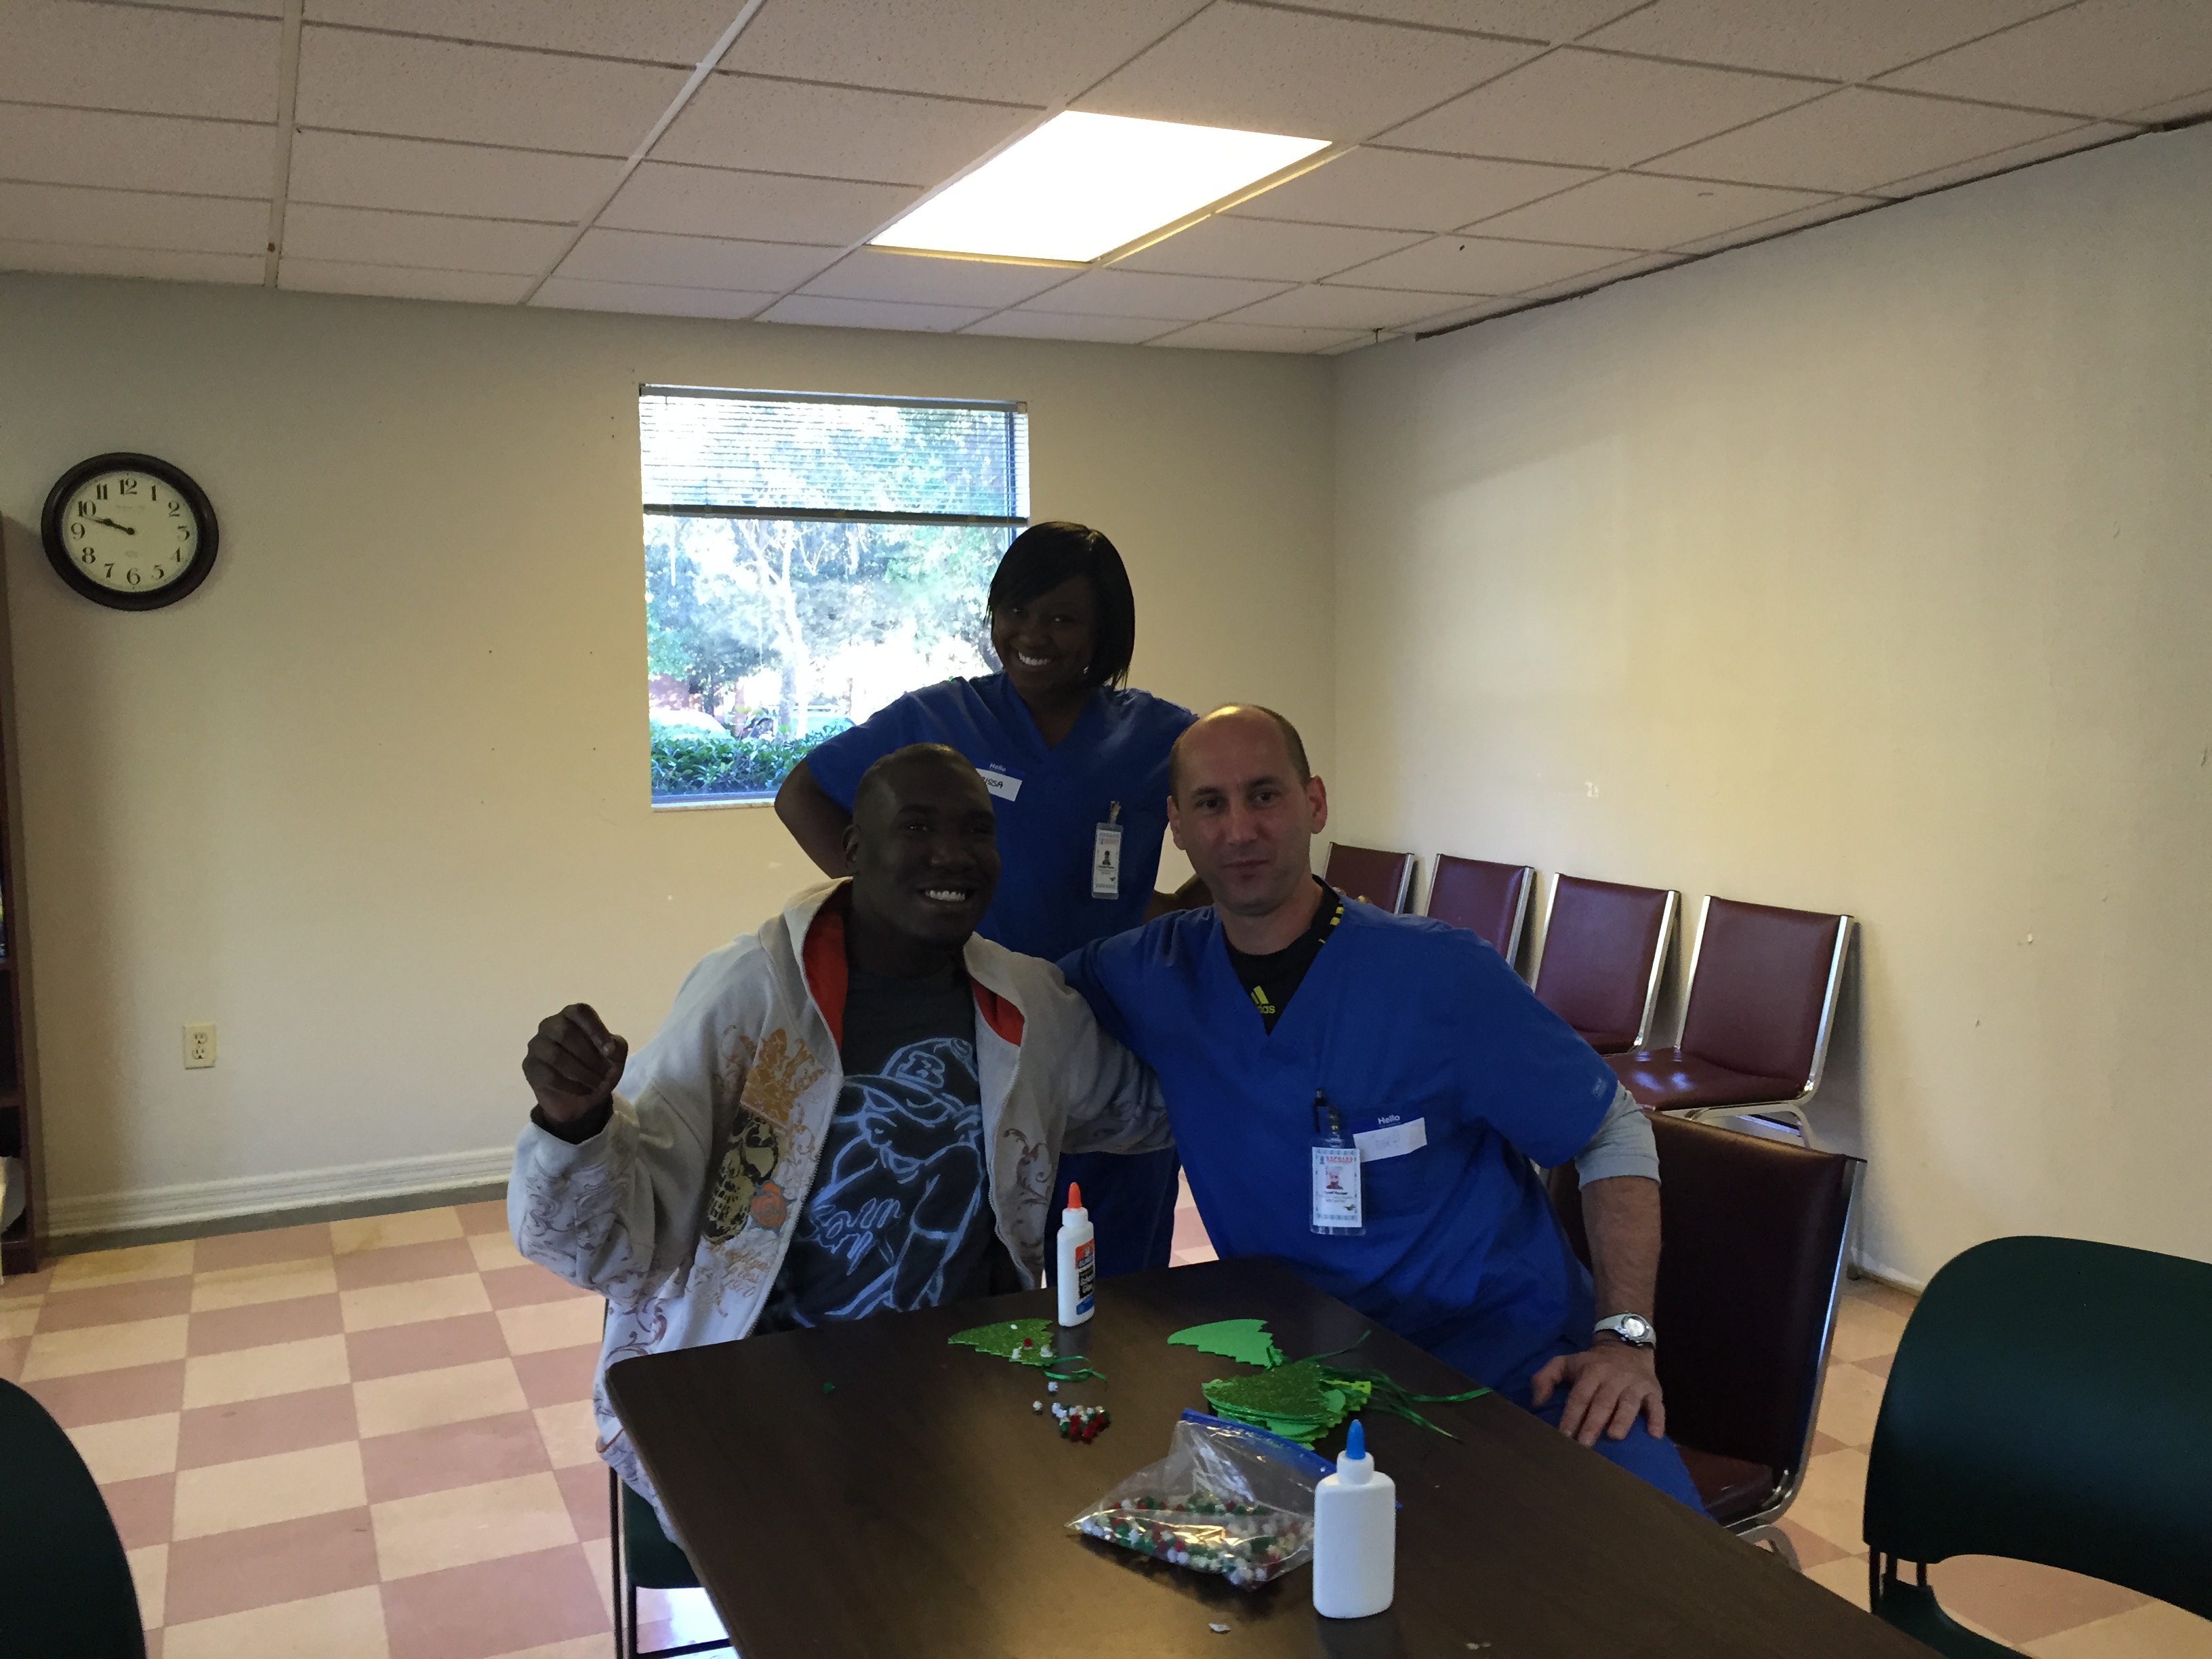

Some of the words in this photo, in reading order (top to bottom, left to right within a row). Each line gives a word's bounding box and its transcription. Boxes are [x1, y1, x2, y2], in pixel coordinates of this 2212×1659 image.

[96, 483, 108, 500] 11
[119, 478, 138, 495] 12
[150, 485, 157, 501] 1
[78, 499, 97, 517] 10
[168, 500, 180, 517] 2
[70, 523, 85, 540] 9
[177, 525, 190, 542] 3
[81, 546, 96, 564] 8
[170, 546, 184, 563] 4
[104, 562, 115, 579] 7
[127, 567, 141, 586] 6
[150, 563, 165, 581] 5
[989, 762, 1006, 772] Hello
[1377, 1114, 1401, 1125] Hello
